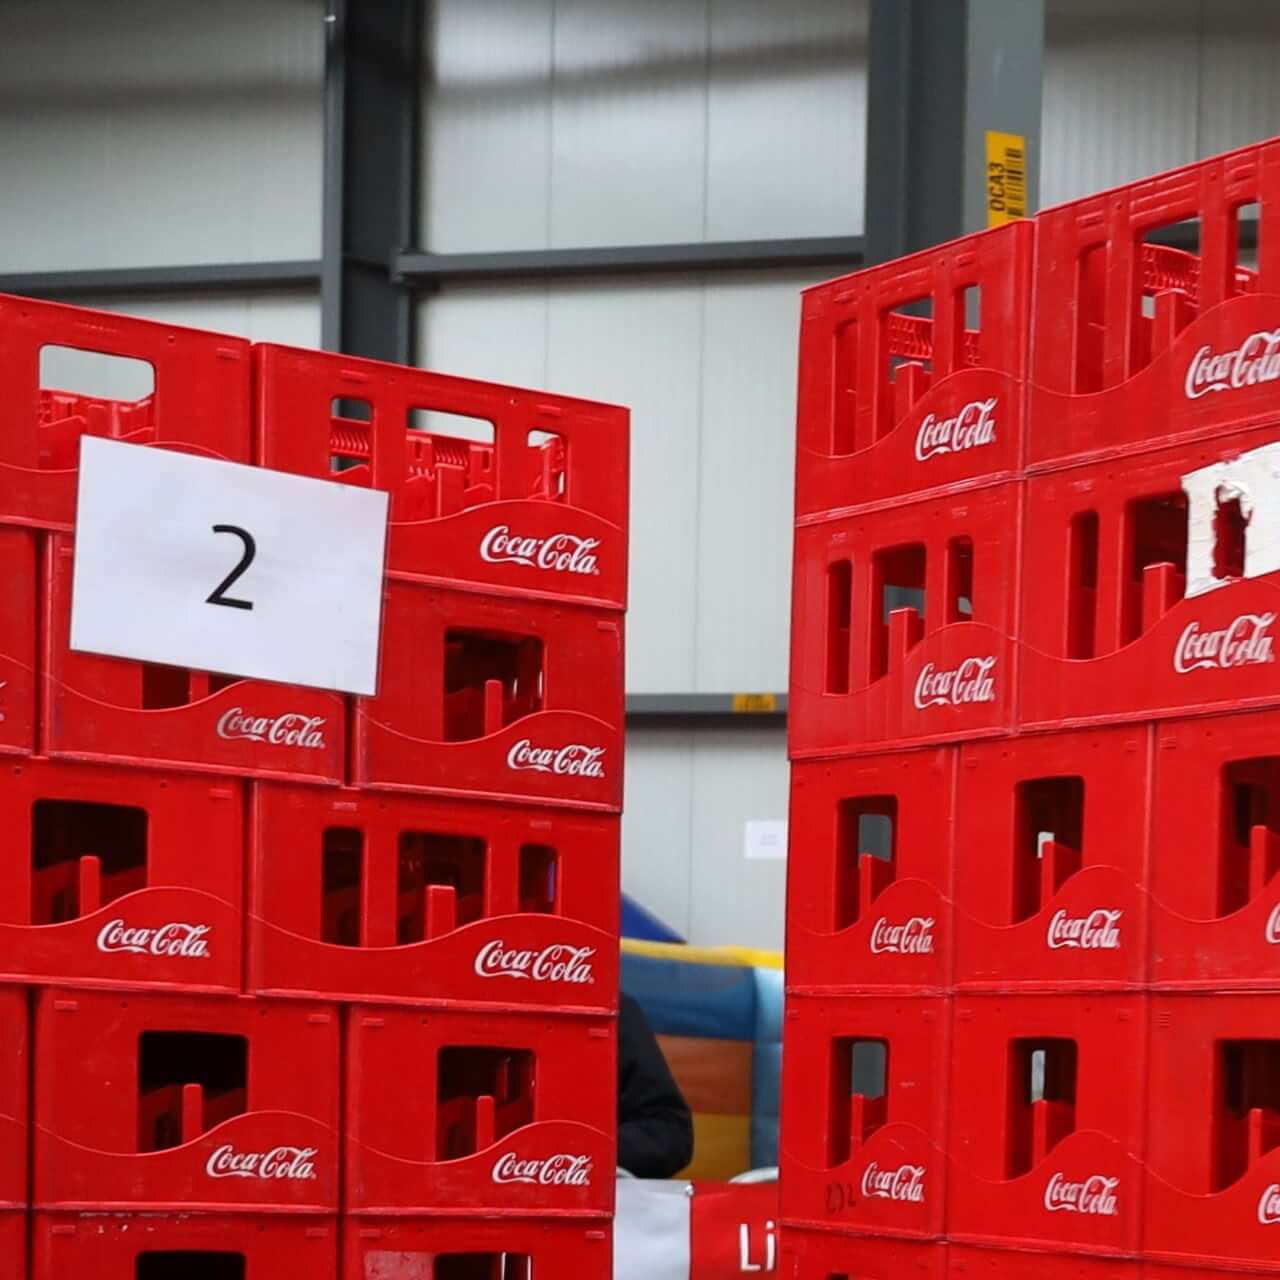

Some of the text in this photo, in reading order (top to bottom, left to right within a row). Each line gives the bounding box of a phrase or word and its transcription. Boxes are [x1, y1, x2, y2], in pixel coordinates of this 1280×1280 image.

[915, 398, 998, 461] Coca-Cola
[205, 524, 256, 611] 2
[479, 525, 600, 575] Coca-Cola
[1173, 612, 1276, 673] Coca-Cola
[914, 655, 996, 709] Coca-Cola
[216, 707, 326, 748] Coca-Cola
[507, 739, 605, 778] Coca-Cola
[96, 919, 210, 957] Coca-Cola
[870, 917, 935, 954] Coca-Cola
[1047, 909, 1122, 949] Coca-Cola
[474, 940, 596, 983] Coca-Cola
[206, 1144, 318, 1179] Coca-Cola
[492, 1152, 590, 1185] Coca-Cola
[861, 1162, 925, 1202] Coca-Cola
[1044, 1172, 1120, 1215] Coca-Cola
[740, 1220, 776, 1271] Li
